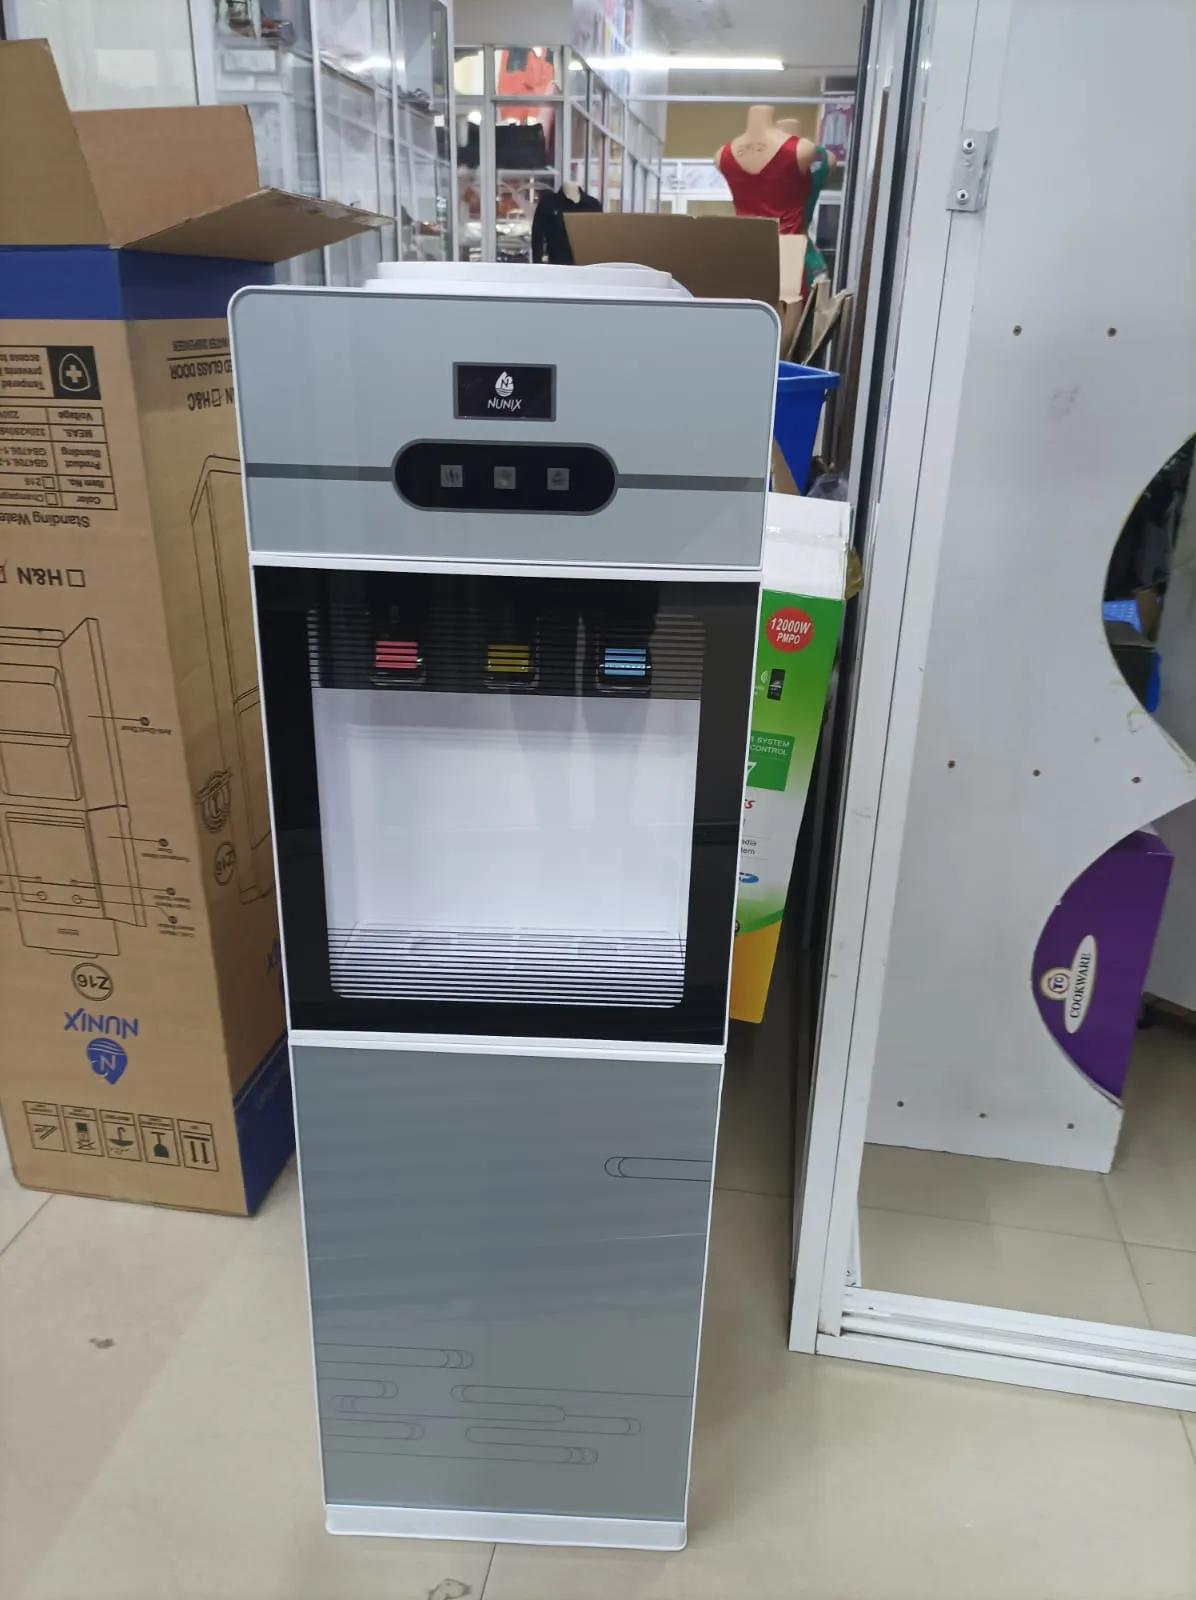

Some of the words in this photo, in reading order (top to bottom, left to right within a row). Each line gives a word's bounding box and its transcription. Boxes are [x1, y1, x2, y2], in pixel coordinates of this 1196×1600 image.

[169, 362, 197, 380] DOOR
[197, 360, 224, 377] GLASS
[187, 390, 211, 411] H&C
[487, 397, 522, 412] NUNIX
[58, 410, 93, 421] Voltage
[60, 447, 101, 458] Standing
[76, 495, 102, 505] Color
[32, 510, 90, 528] Standing
[17, 566, 63, 587] H&N
[771, 618, 812, 634] 12000W
[776, 632, 801, 645] PMPO
[757, 736, 790, 748] SYSTEM
[77, 974, 111, 991] Z16
[1069, 952, 1092, 1019] COOKWARE
[64, 1007, 139, 1039] NUNIX
